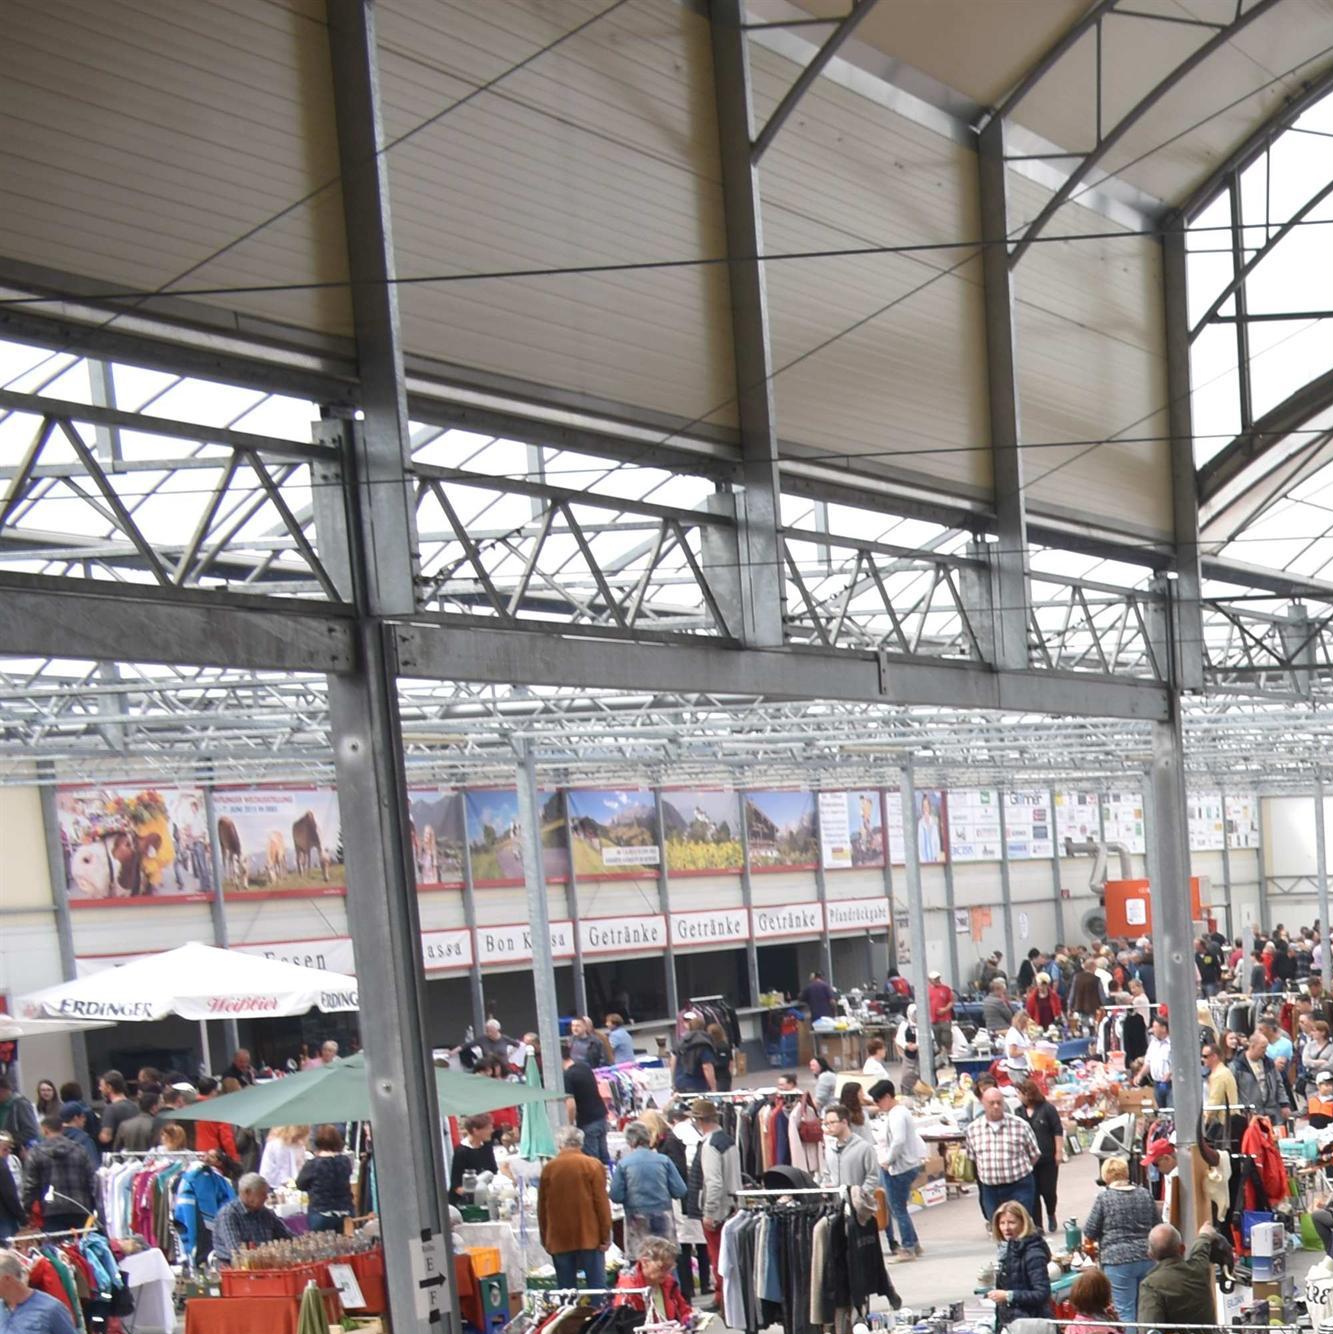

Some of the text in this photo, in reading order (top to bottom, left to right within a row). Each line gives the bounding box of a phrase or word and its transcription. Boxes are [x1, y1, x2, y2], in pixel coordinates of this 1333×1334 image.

[677, 919, 741, 939] Getränke
[758, 913, 816, 932] Getränke
[486, 932, 565, 952] Bon Ksa
[589, 926, 658, 947] Getränke
[427, 942, 462, 959] assa
[59, 998, 152, 1017] ERDINGER
[320, 991, 359, 1009] ERDING
[426, 1257, 433, 1272] E
